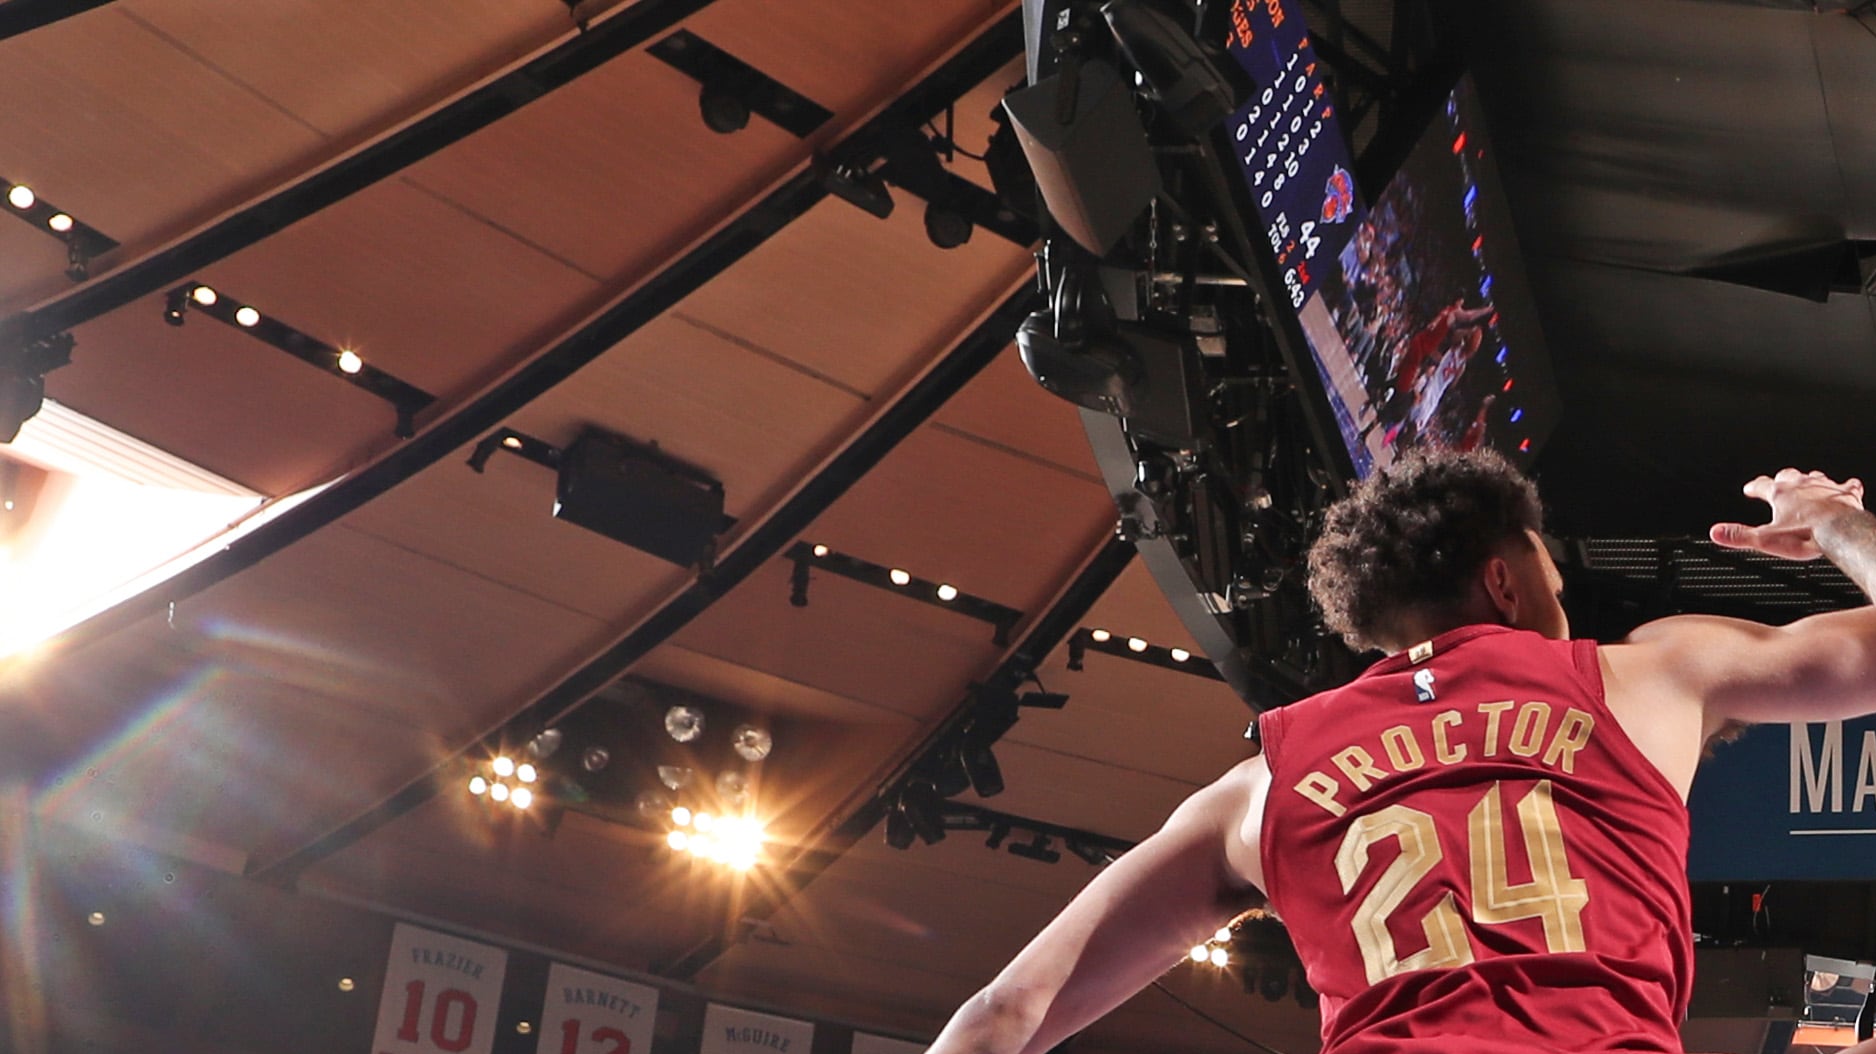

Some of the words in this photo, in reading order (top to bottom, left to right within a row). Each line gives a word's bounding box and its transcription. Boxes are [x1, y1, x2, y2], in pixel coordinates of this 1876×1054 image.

[1284, 152, 1299, 177] 10
[1268, 223, 1282, 253] TOL
[1276, 211, 1290, 238] FLS
[1300, 220, 1320, 260] 44
[1284, 268, 1304, 308] 6:43
[1293, 700, 1596, 817] PROCTOR
[1334, 779, 1590, 988] 24
[411, 947, 484, 980] FRAZIER
[396, 979, 478, 1053] 10
[562, 987, 642, 1019] BARNETT
